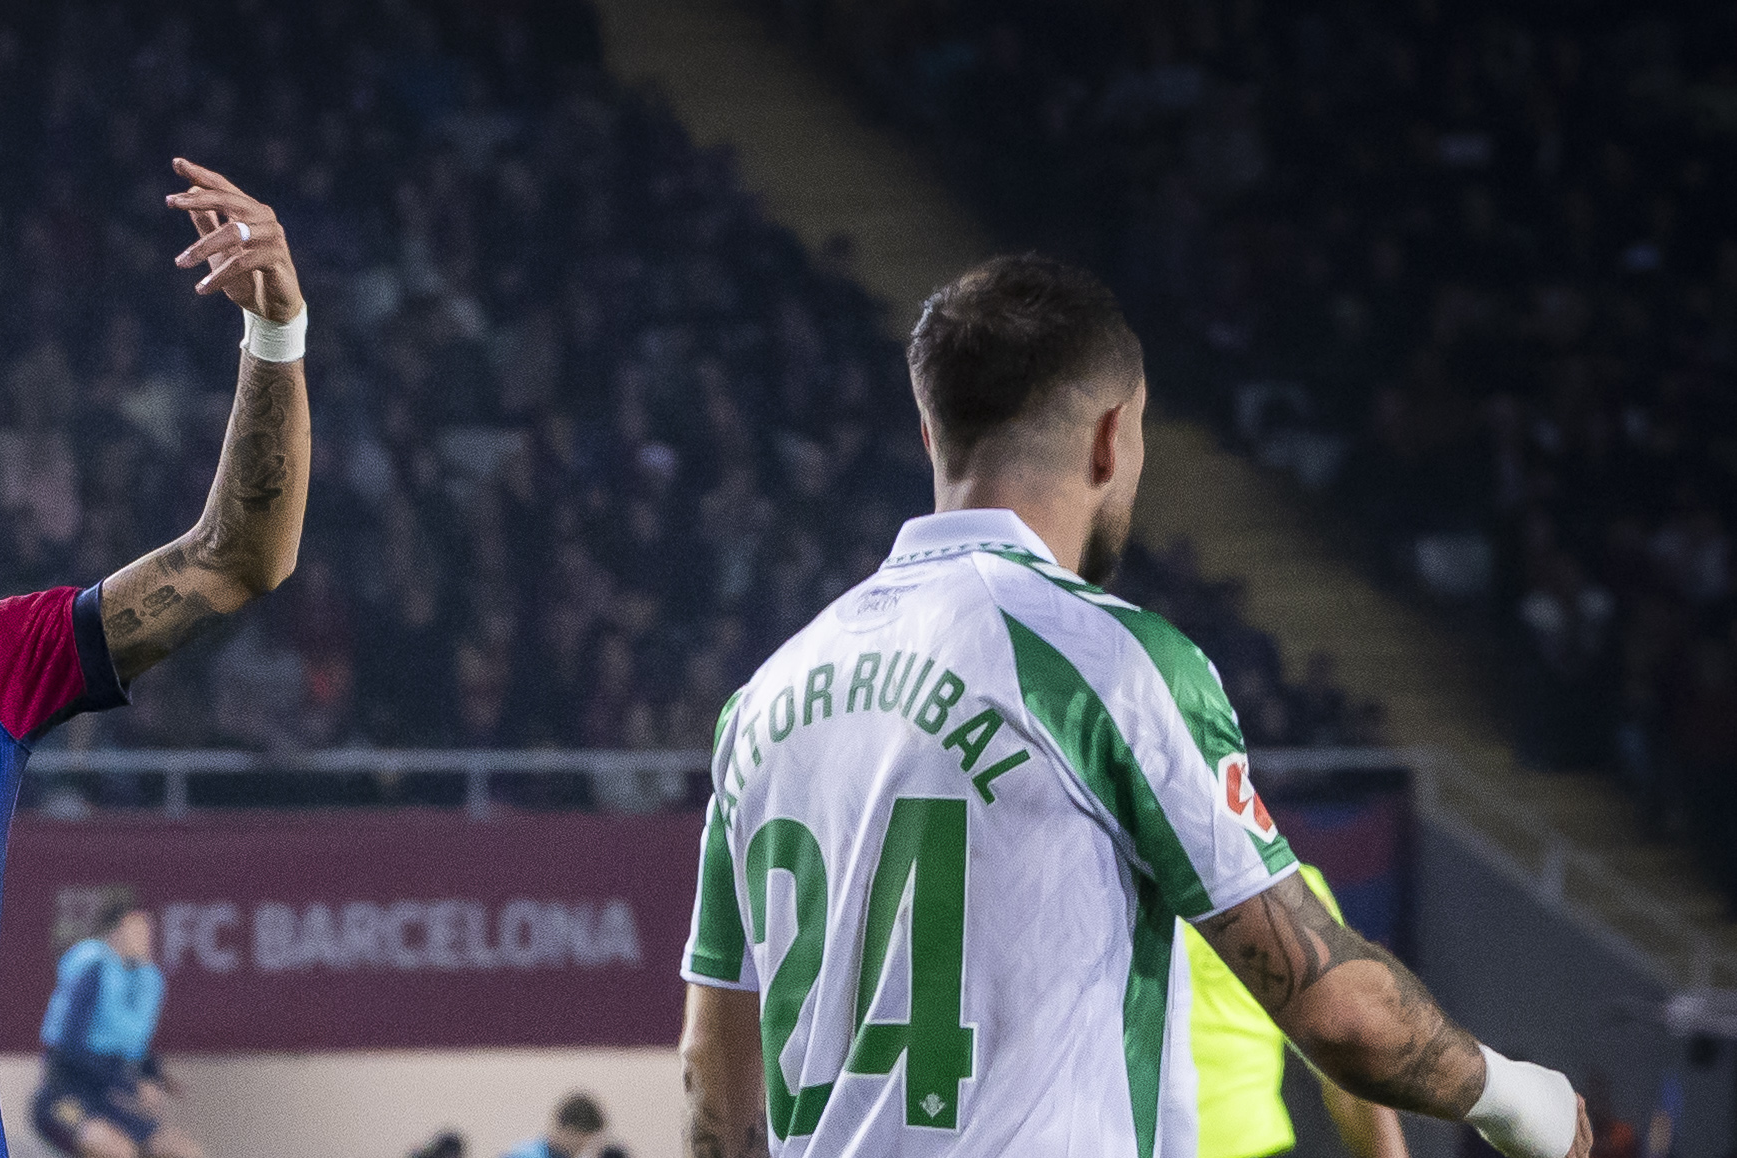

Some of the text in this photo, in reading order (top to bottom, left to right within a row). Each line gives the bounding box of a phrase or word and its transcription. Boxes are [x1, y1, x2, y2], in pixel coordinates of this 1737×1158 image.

[846, 650, 1031, 806] RUIBAL
[162, 898, 642, 973] FC BARCELONA
[744, 796, 977, 1143] 24
